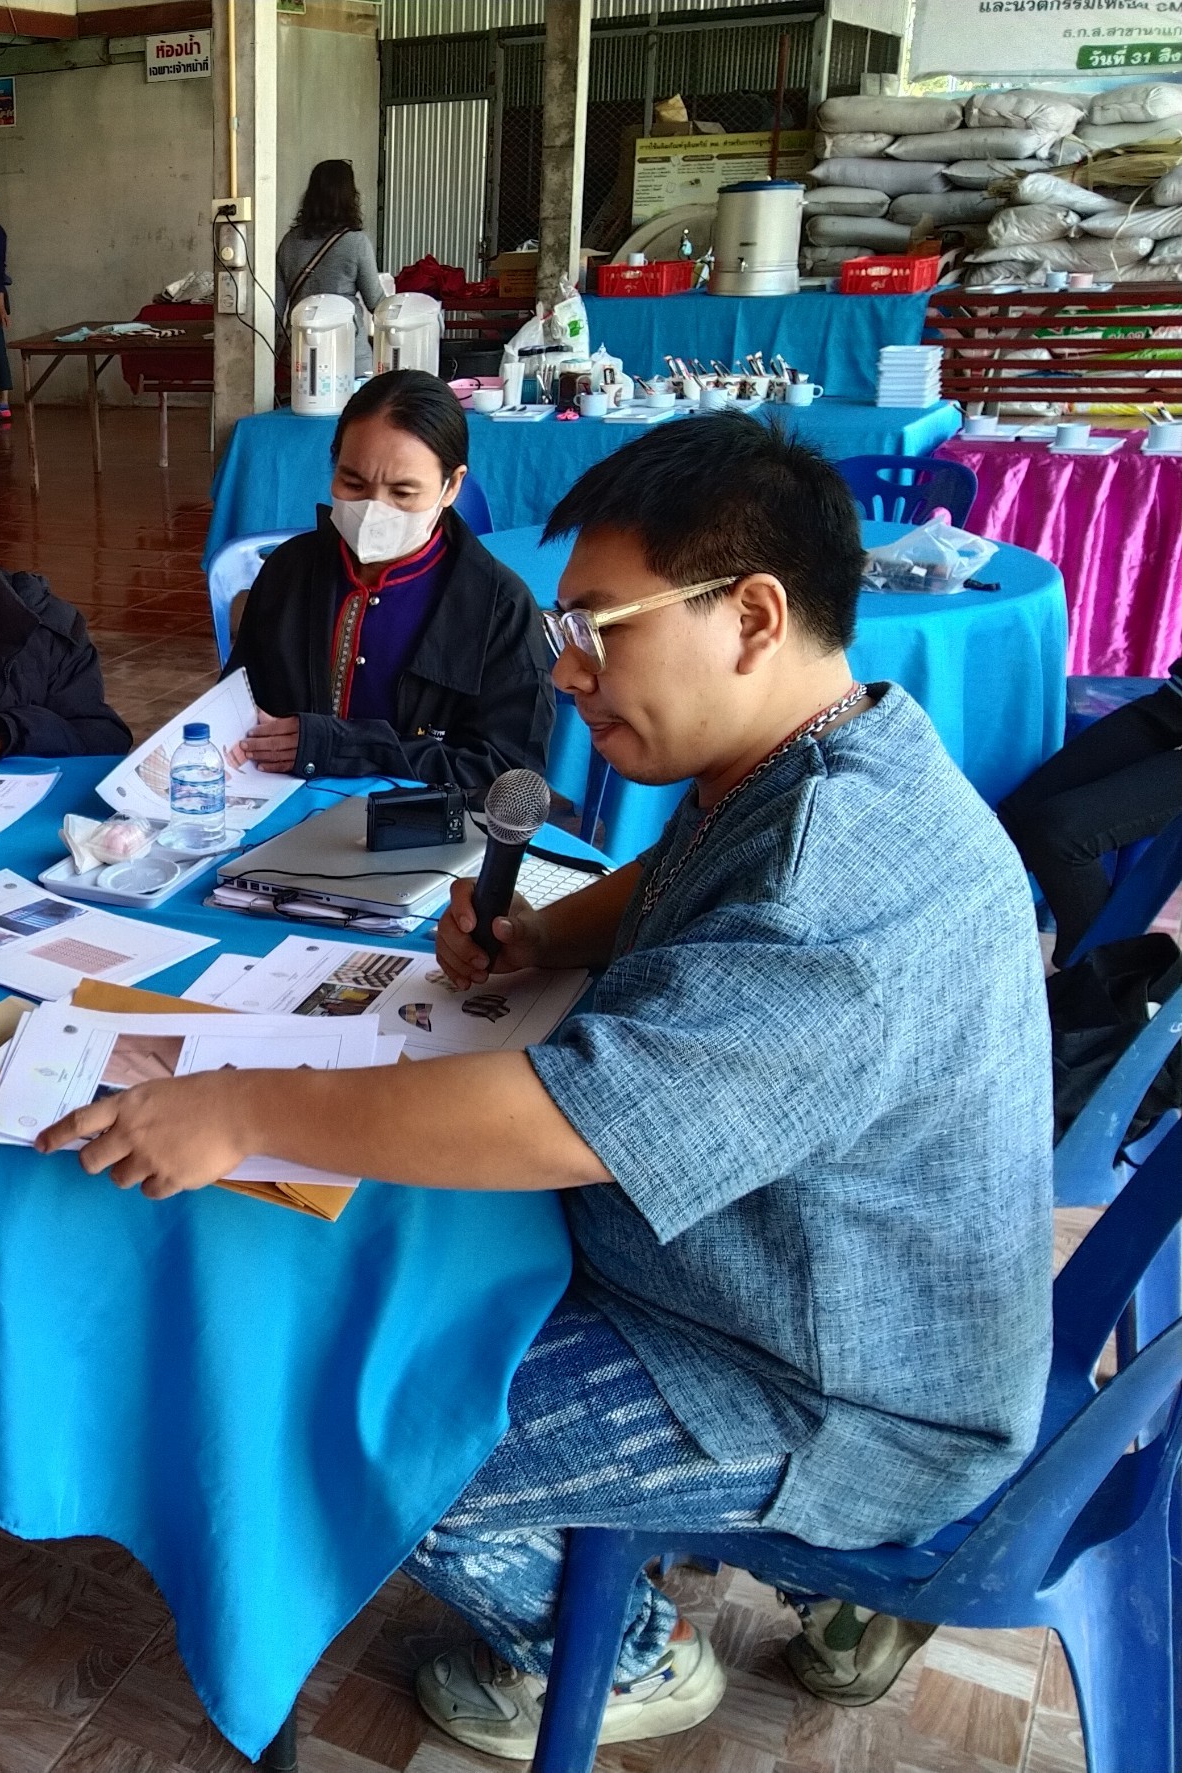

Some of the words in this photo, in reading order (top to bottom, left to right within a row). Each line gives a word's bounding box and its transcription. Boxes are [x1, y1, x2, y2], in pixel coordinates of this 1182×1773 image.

[155, 34, 201, 59] ห้องน้ำ
[1088, 45, 1128, 66] วันที่
[1130, 50, 1153, 65] 31
[148, 55, 209, 77] เฉพาะเจ้าหน้าที่
